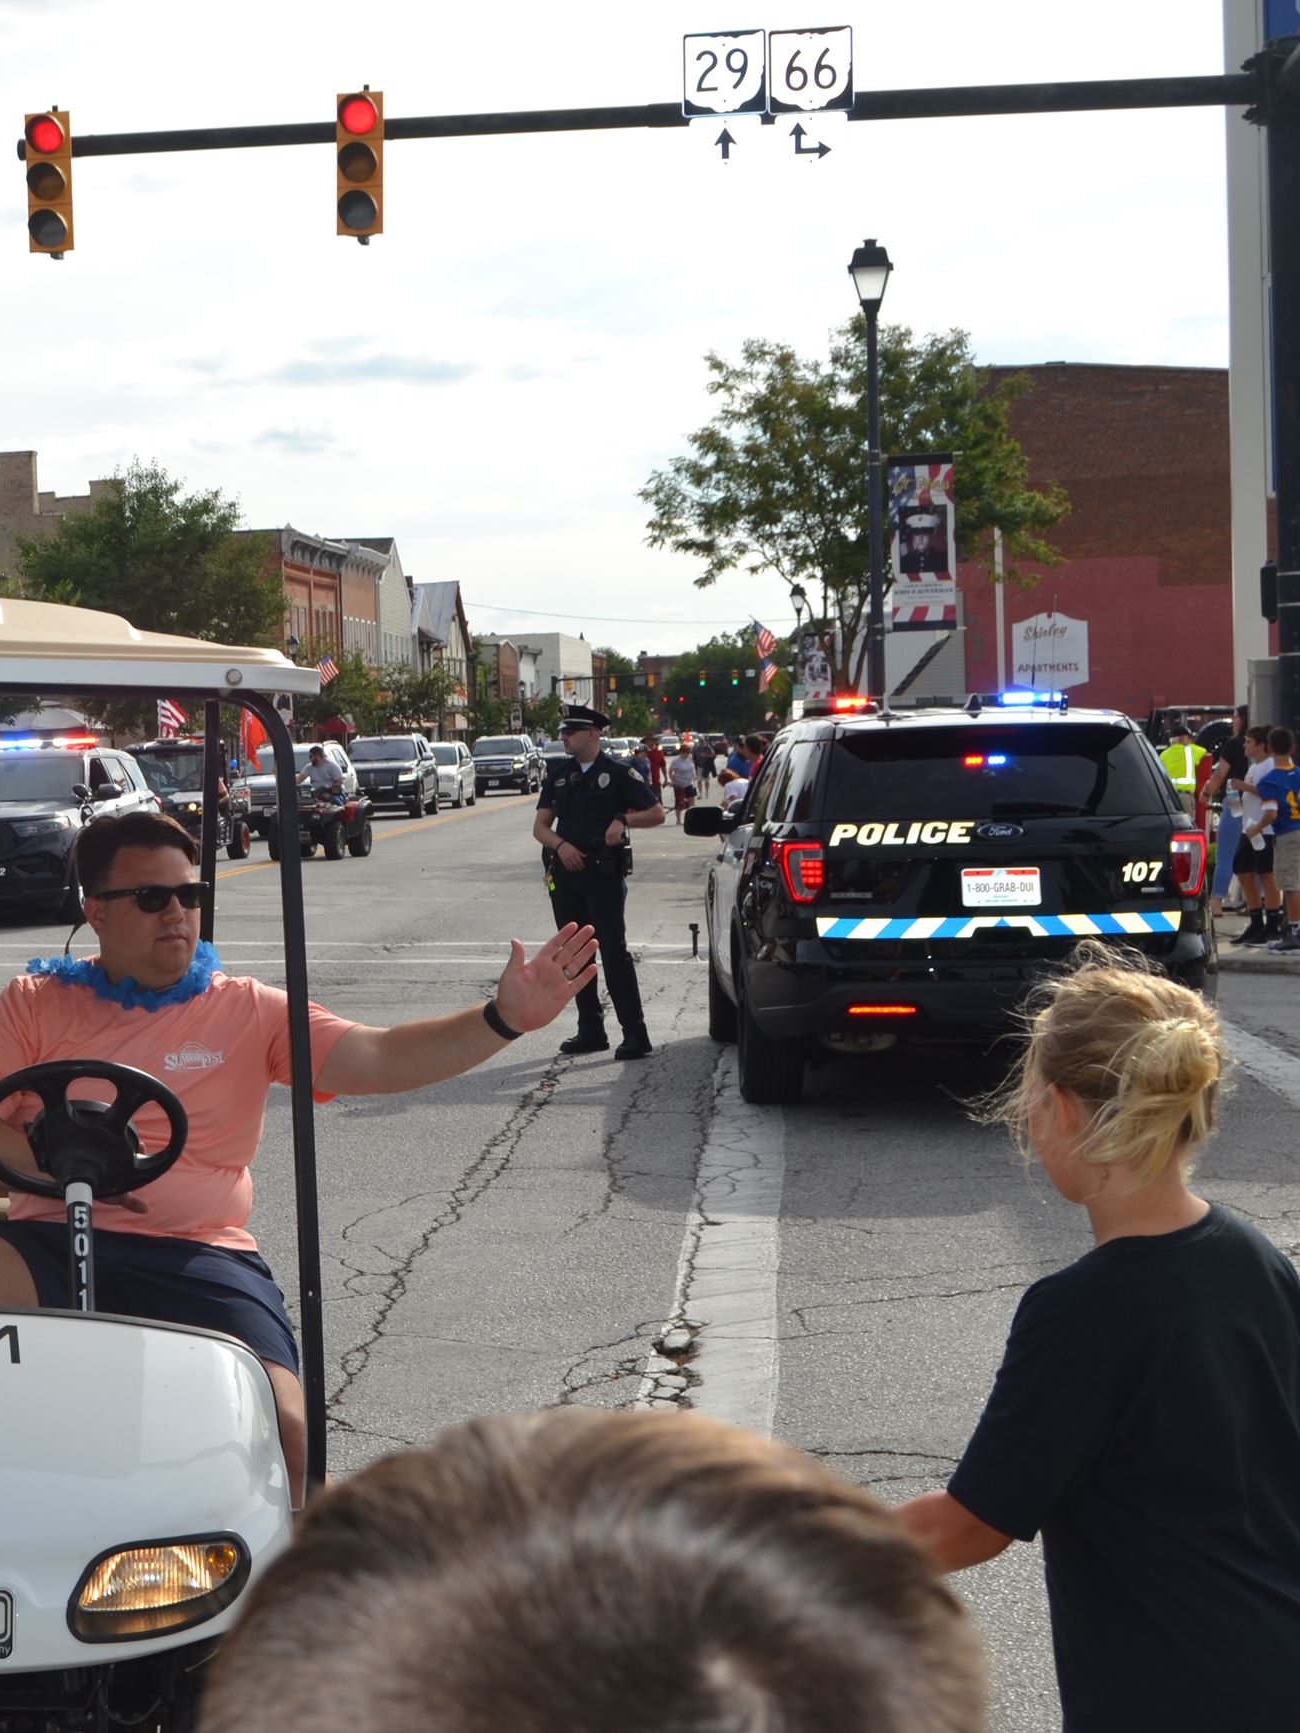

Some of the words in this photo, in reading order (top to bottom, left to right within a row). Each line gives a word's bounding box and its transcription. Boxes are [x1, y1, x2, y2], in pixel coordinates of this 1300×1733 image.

[696, 48, 749, 92] 29
[785, 47, 837, 91] 66
[1018, 662, 1079, 673] APARTMENTS
[829, 821, 975, 847] POLICE
[1122, 861, 1163, 882] 107
[967, 882, 1034, 893] 1-800-GRAB-DUI
